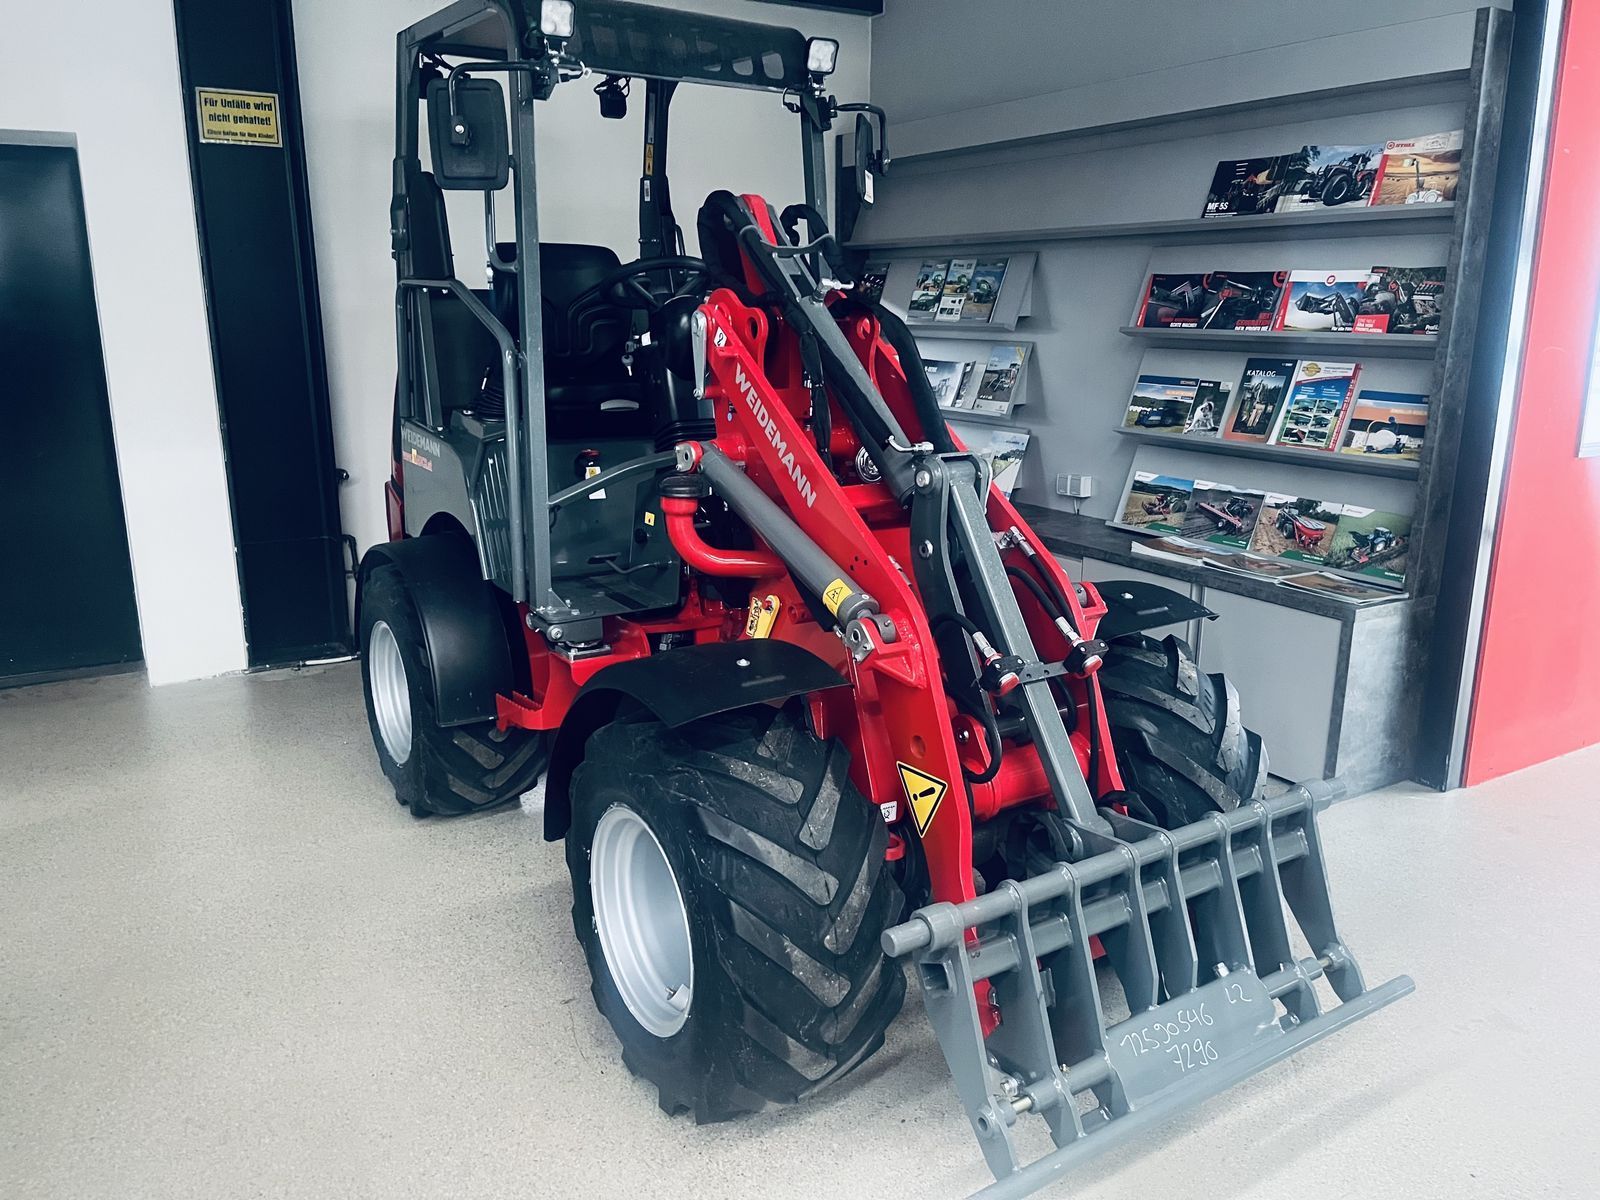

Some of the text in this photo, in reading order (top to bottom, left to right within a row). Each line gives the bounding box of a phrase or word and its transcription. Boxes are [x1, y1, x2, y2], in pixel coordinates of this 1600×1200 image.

[204, 97, 273, 111] Für Unfälle wird
[208, 113, 272, 126] nicht gehaftet!
[1246, 369, 1277, 377] KATALOG
[401, 425, 441, 458] WEIDEMANN
[734, 362, 817, 509] WEIDEMANN
